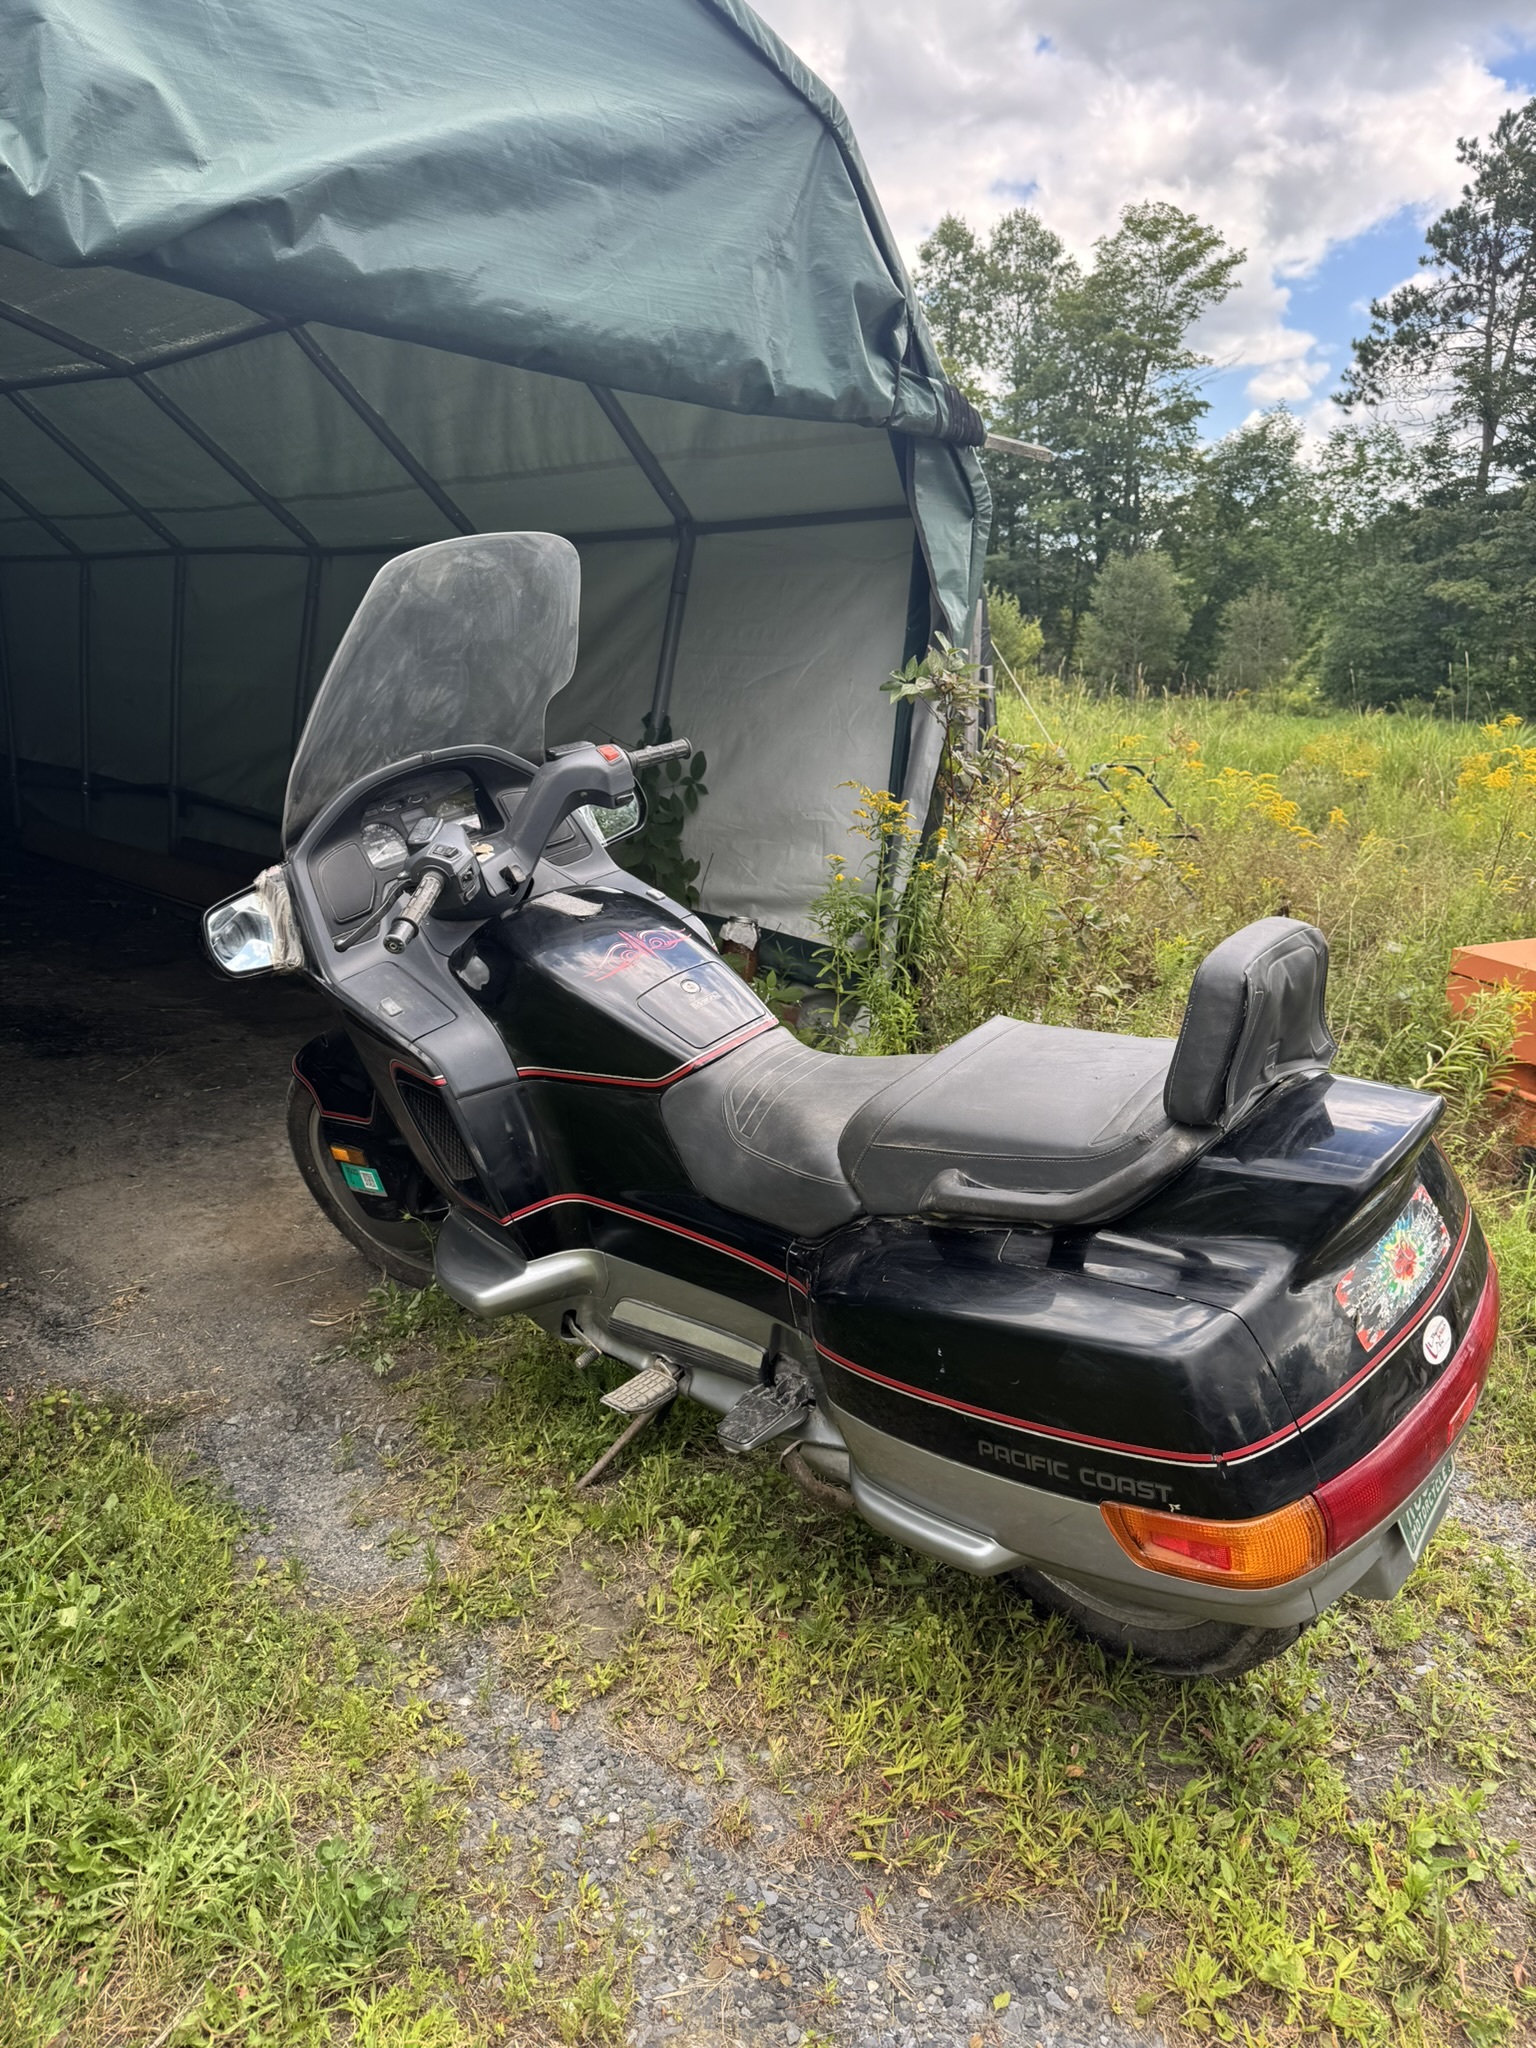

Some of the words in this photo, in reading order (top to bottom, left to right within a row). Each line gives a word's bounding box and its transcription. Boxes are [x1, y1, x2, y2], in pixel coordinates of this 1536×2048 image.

[979, 1440, 1070, 1480] PACIFIC
[1079, 1467, 1173, 1502] COAST
[1411, 1466, 1447, 1547] MOTORCYCLE
